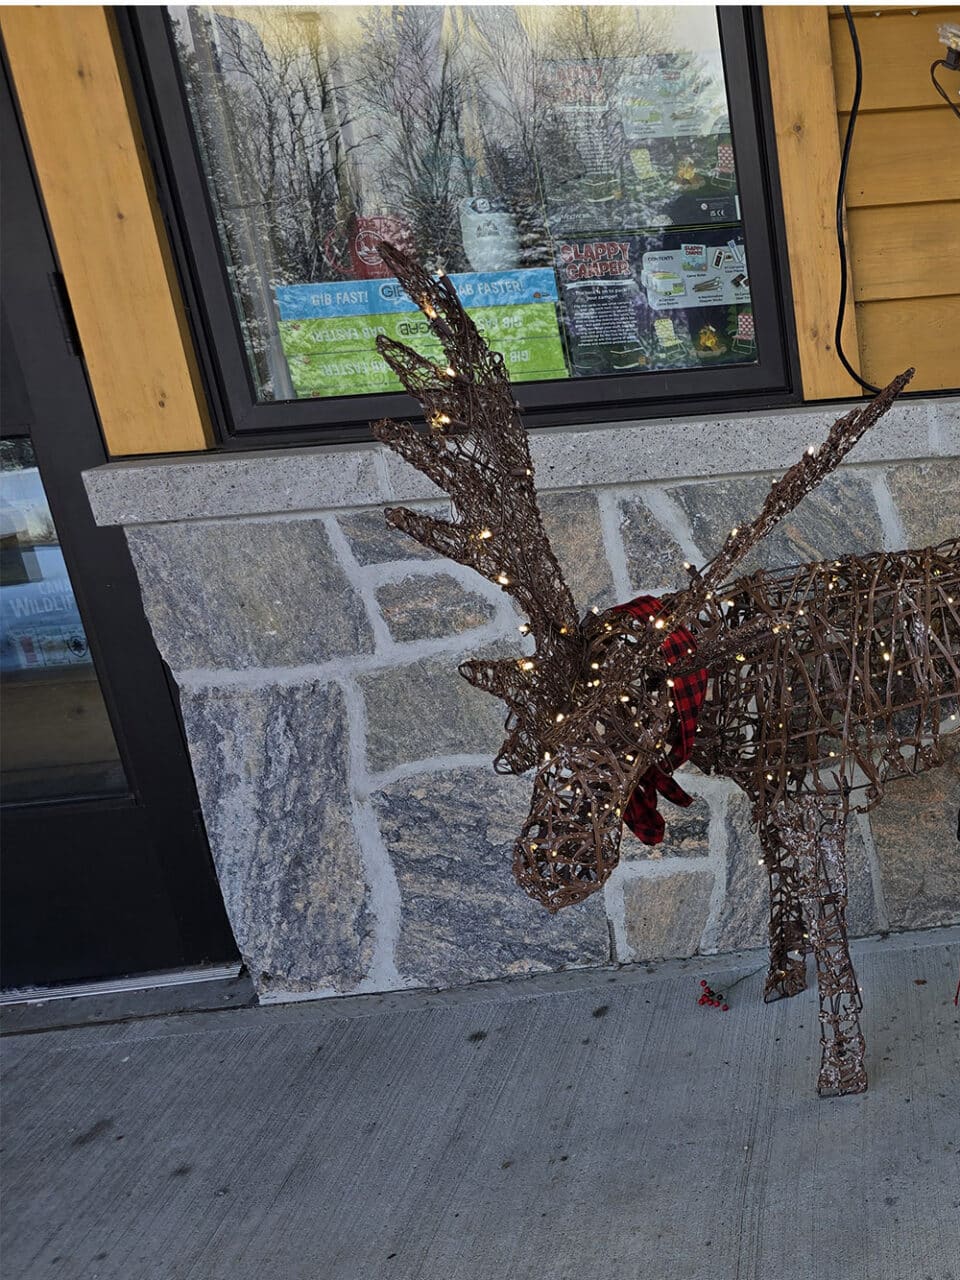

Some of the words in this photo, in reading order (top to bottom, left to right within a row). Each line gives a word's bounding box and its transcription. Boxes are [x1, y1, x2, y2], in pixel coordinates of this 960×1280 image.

[560, 242, 631, 263] SLAPPY
[566, 260, 632, 280] CAMPER
[477, 280, 526, 295] FASTER!
[311, 294, 332, 306] GIB
[336, 290, 369, 305] FAST!
